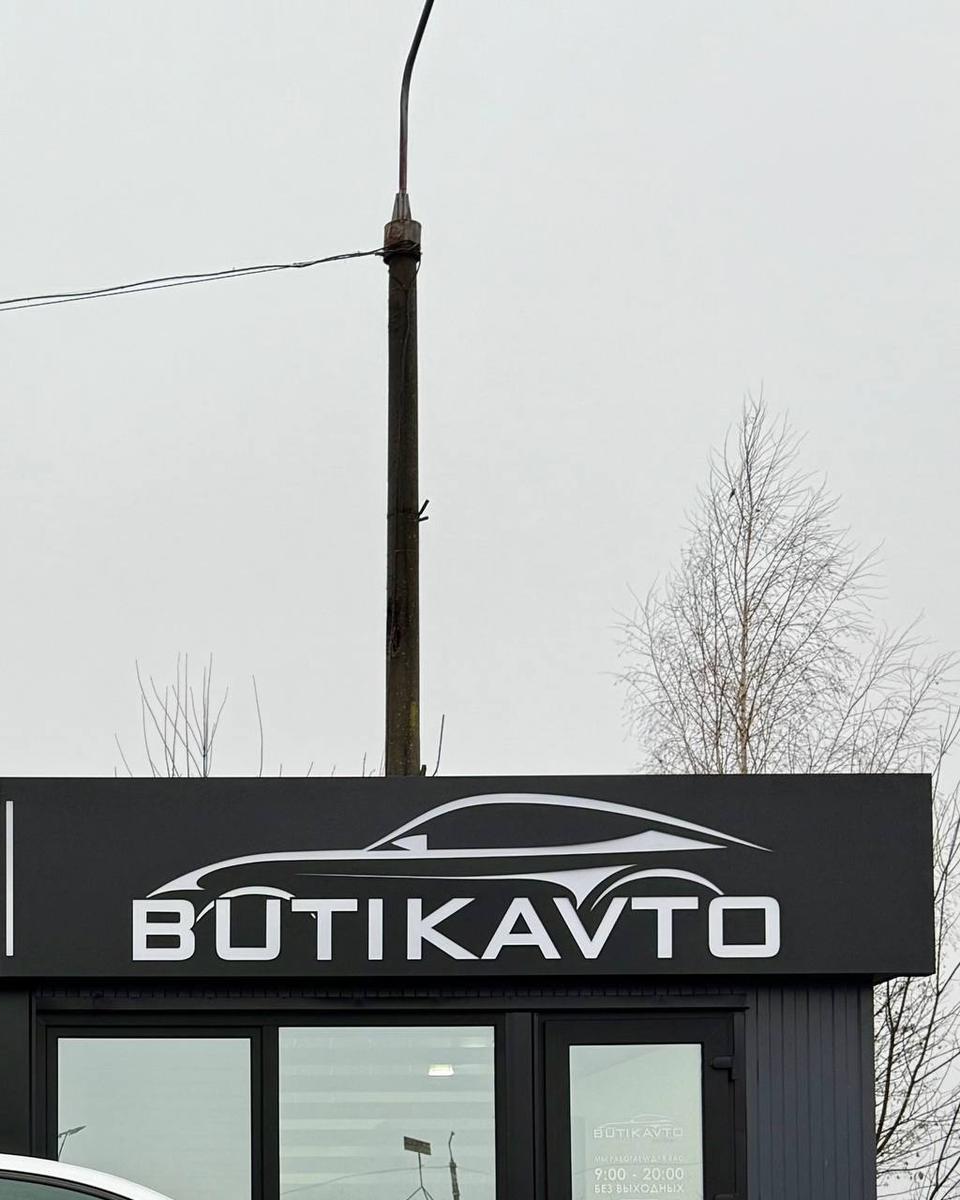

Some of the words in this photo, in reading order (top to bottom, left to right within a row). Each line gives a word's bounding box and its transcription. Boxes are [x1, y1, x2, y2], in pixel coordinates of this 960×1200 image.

[131, 896, 782, 961] BUTIKAVTO
[593, 1127, 684, 1139] BUTIKAVTO
[594, 1167, 626, 1181] 9:00
[642, 1167, 684, 1181] 20:00
[594, 1184, 613, 1194] БЕЗ
[616, 1183, 685, 1193] ВЫХОДНЫХ
